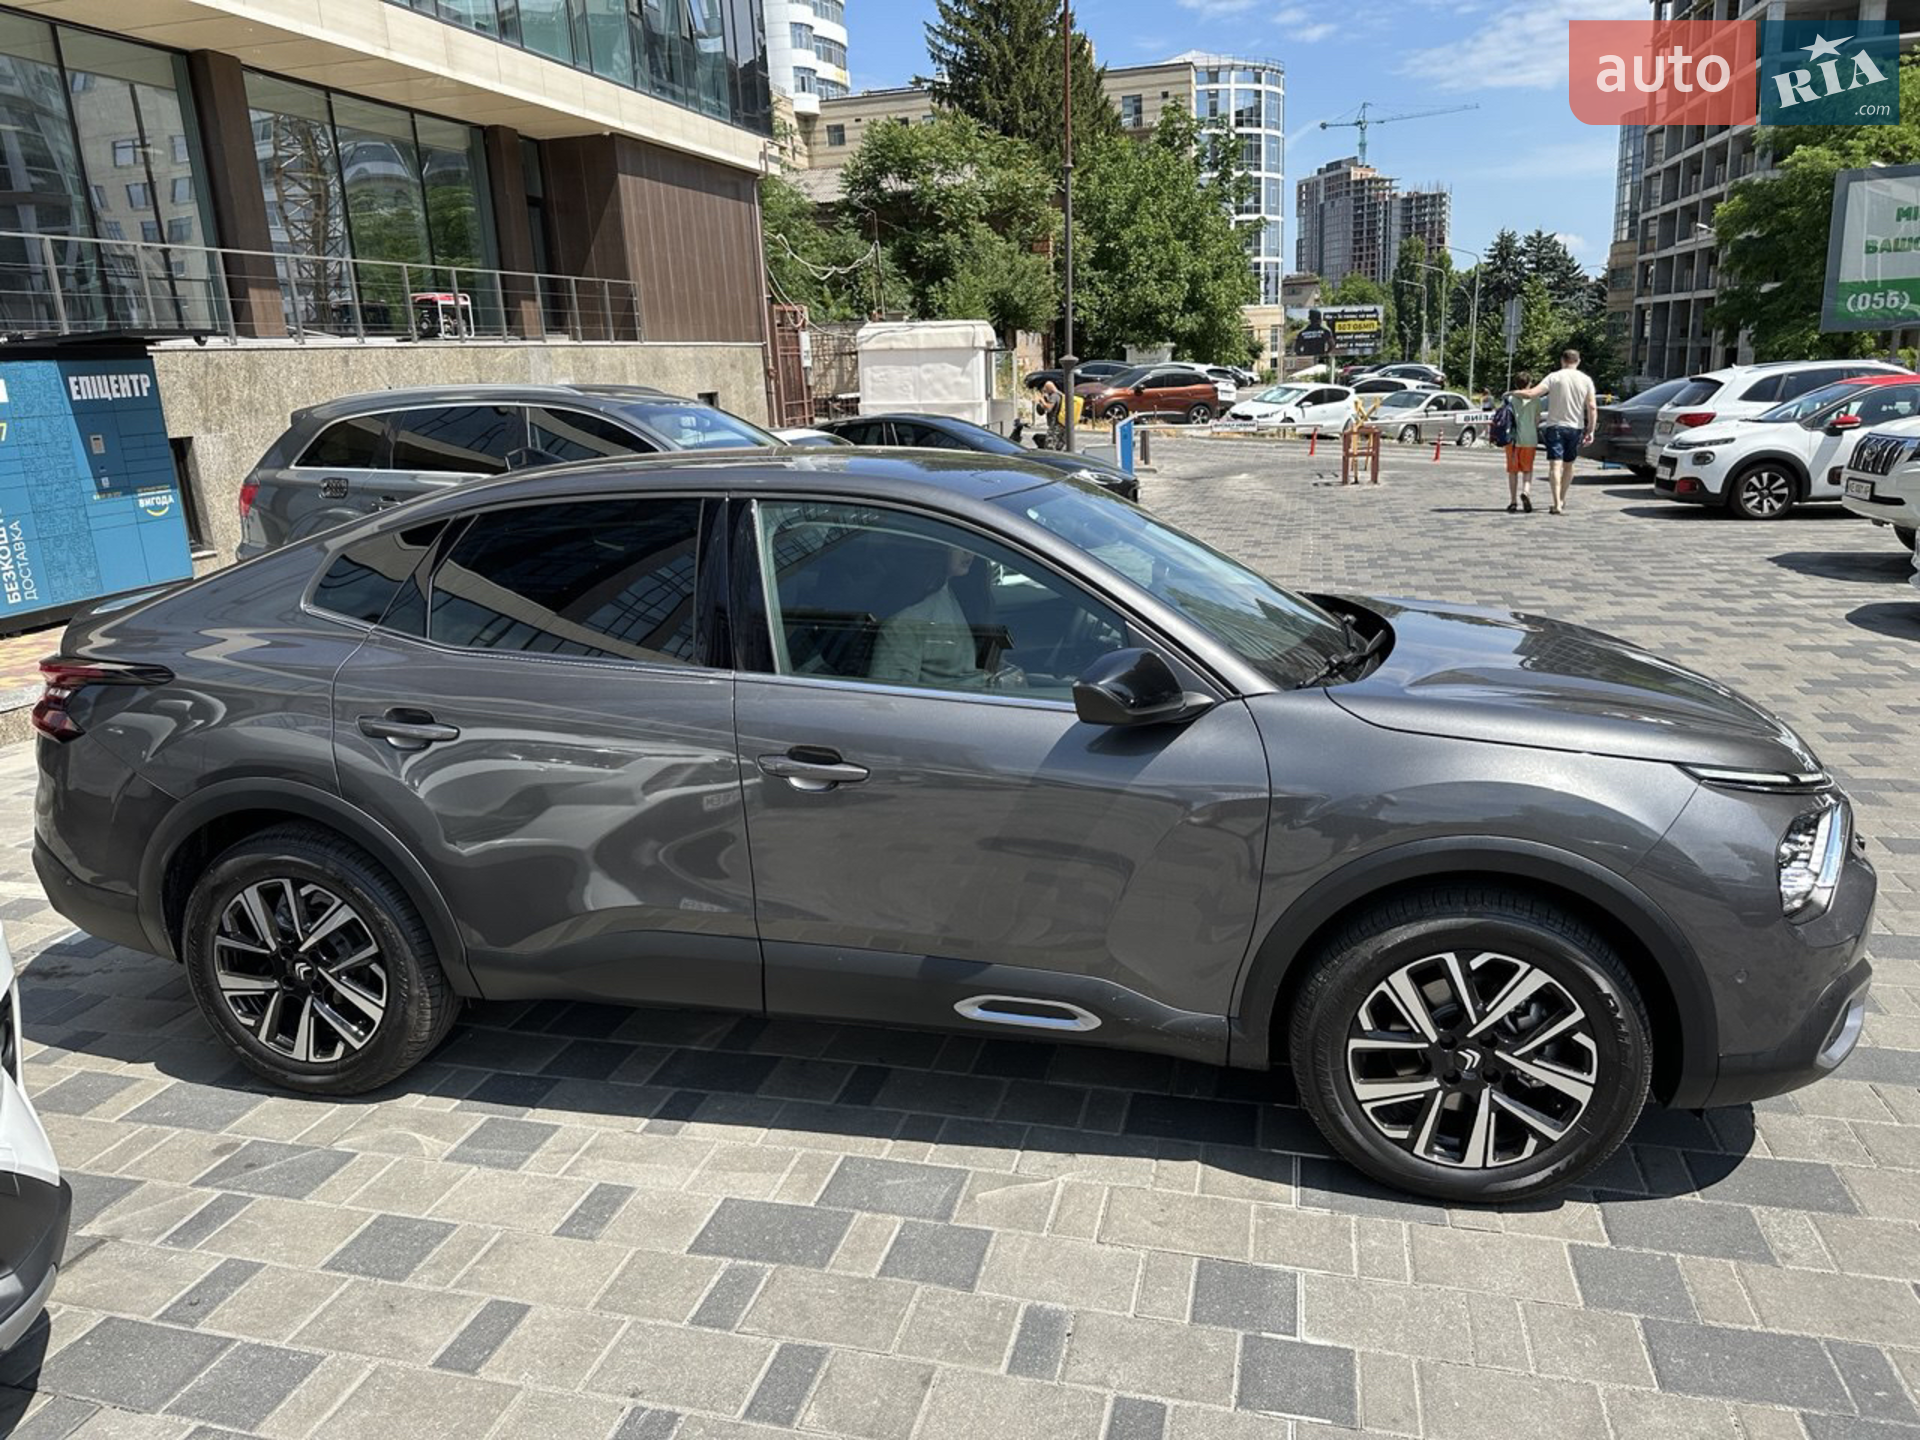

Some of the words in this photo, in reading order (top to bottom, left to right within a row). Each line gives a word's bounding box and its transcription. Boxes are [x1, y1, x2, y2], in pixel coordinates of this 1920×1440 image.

[1846, 287, 1911, 313] (056)
[68, 374, 151, 401] ЕПІЦЕНТР
[138, 494, 175, 508] ВИГОДА
[9, 520, 40, 601] ДОСТАВКА
